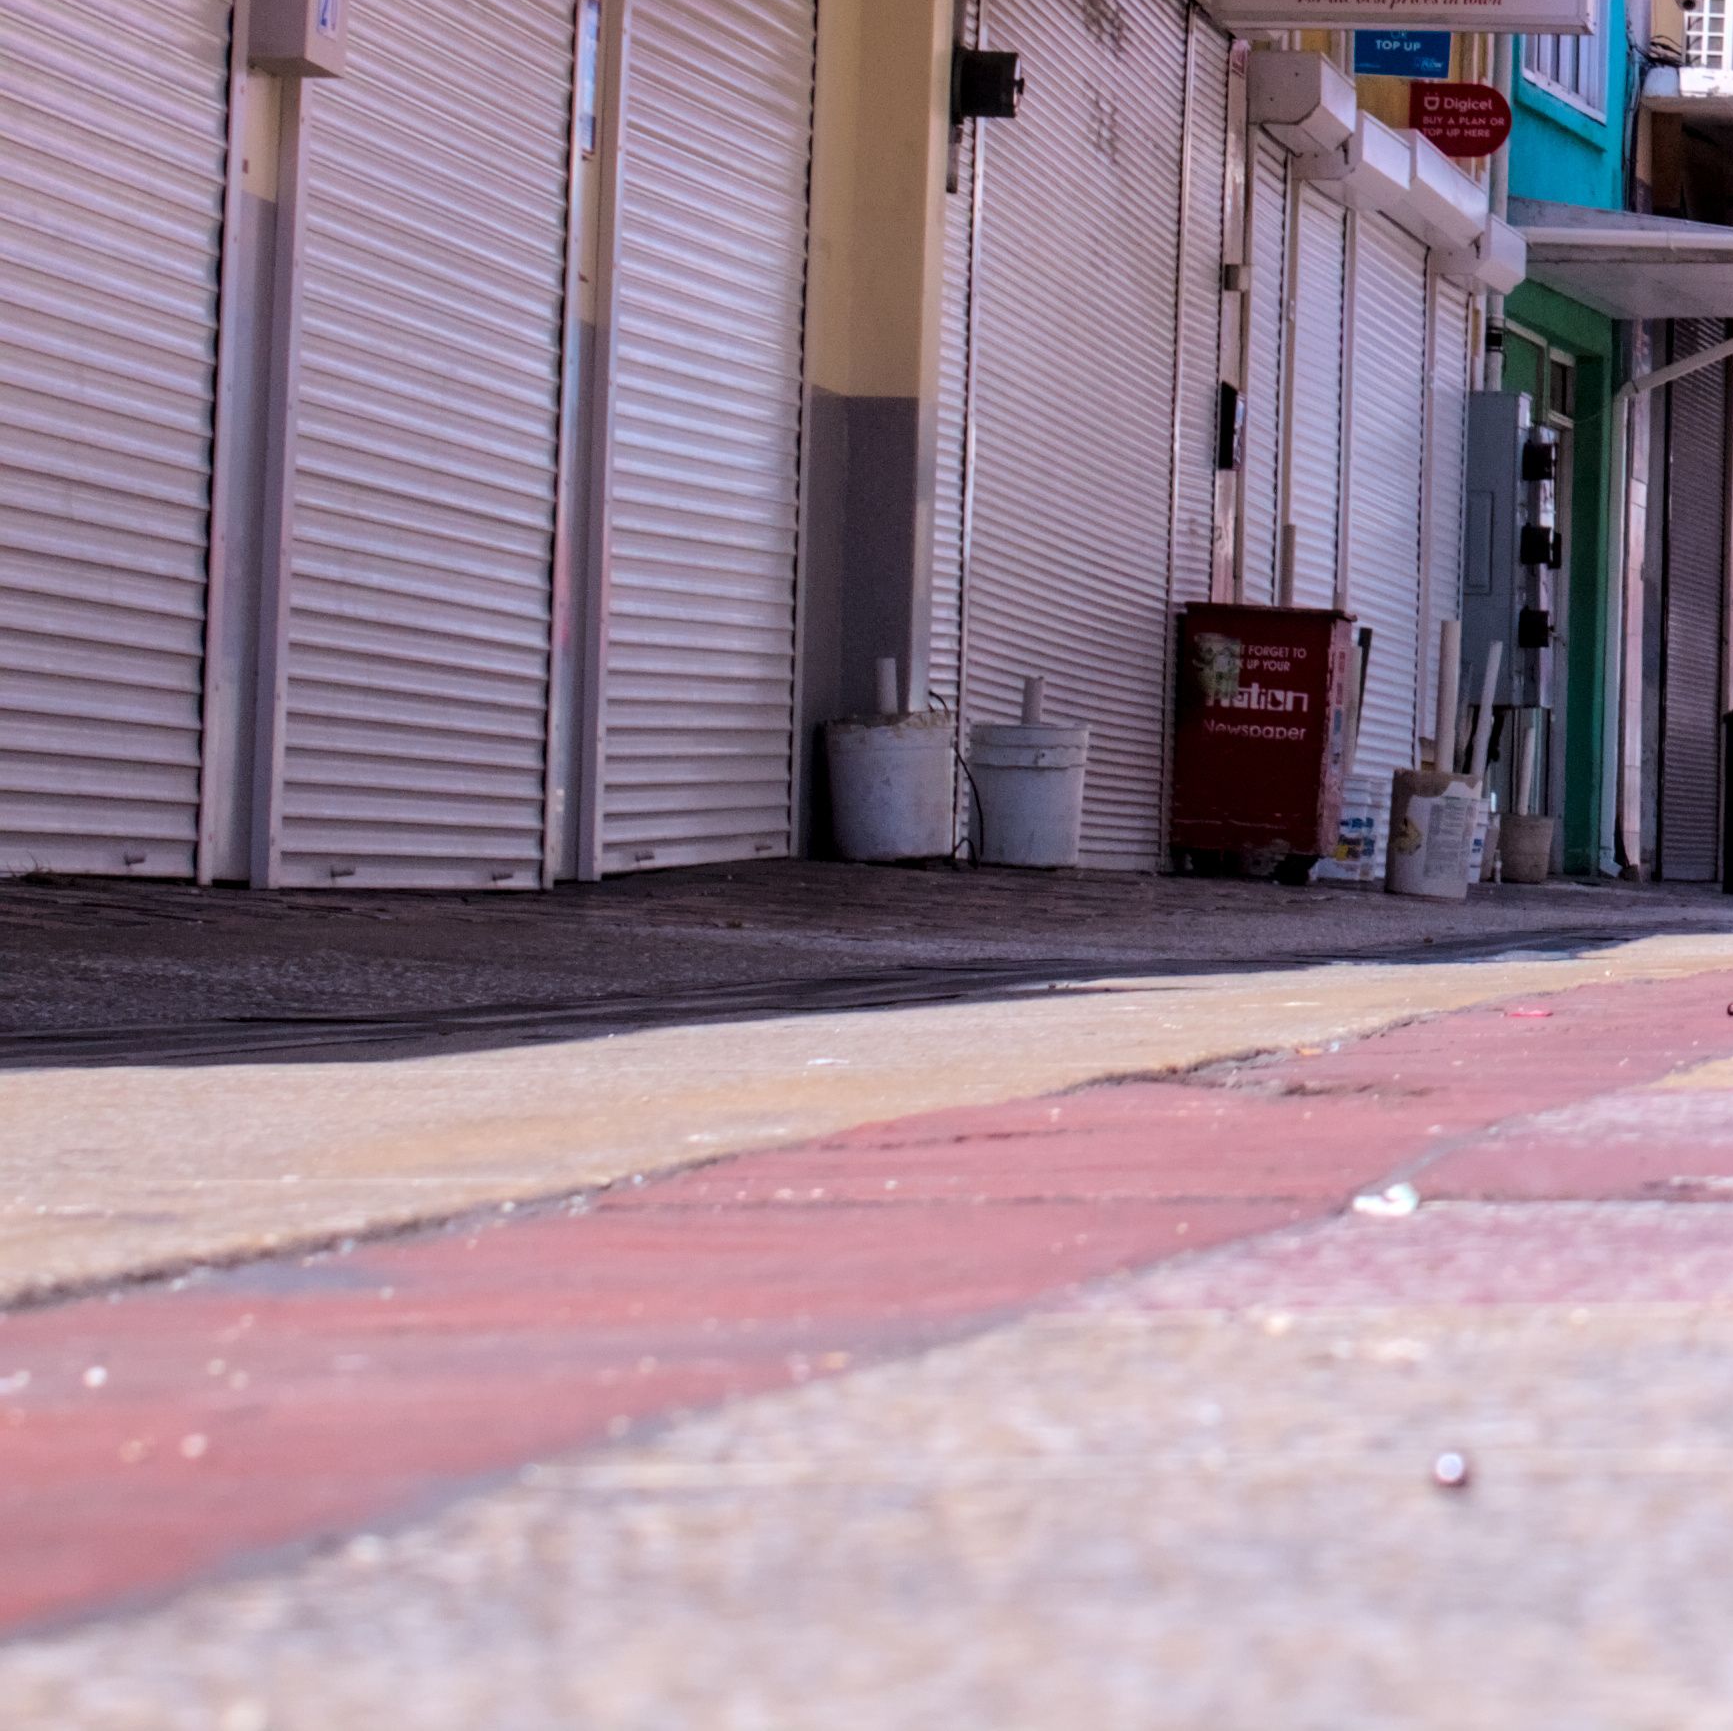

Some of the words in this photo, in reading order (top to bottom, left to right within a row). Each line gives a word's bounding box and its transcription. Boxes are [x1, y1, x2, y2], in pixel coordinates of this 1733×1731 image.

[1375, 39, 1400, 51] TOP
[1403, 41, 1422, 52] UP
[1443, 97, 1493, 113] Digicel
[1422, 115, 1444, 125] BUY
[1447, 116, 1455, 125] A
[1459, 116, 1487, 126] PLAN
[1489, 117, 1505, 126] OR
[1422, 127, 1443, 137] TOP
[1446, 128, 1461, 137] UP
[1463, 129, 1491, 138] HERE
[1248, 644, 1290, 659] FORGET
[1293, 648, 1307, 659] TO
[1246, 659, 1260, 670] UP
[1263, 659, 1291, 672] YOUR
[1202, 718, 1307, 741] Newspaper
